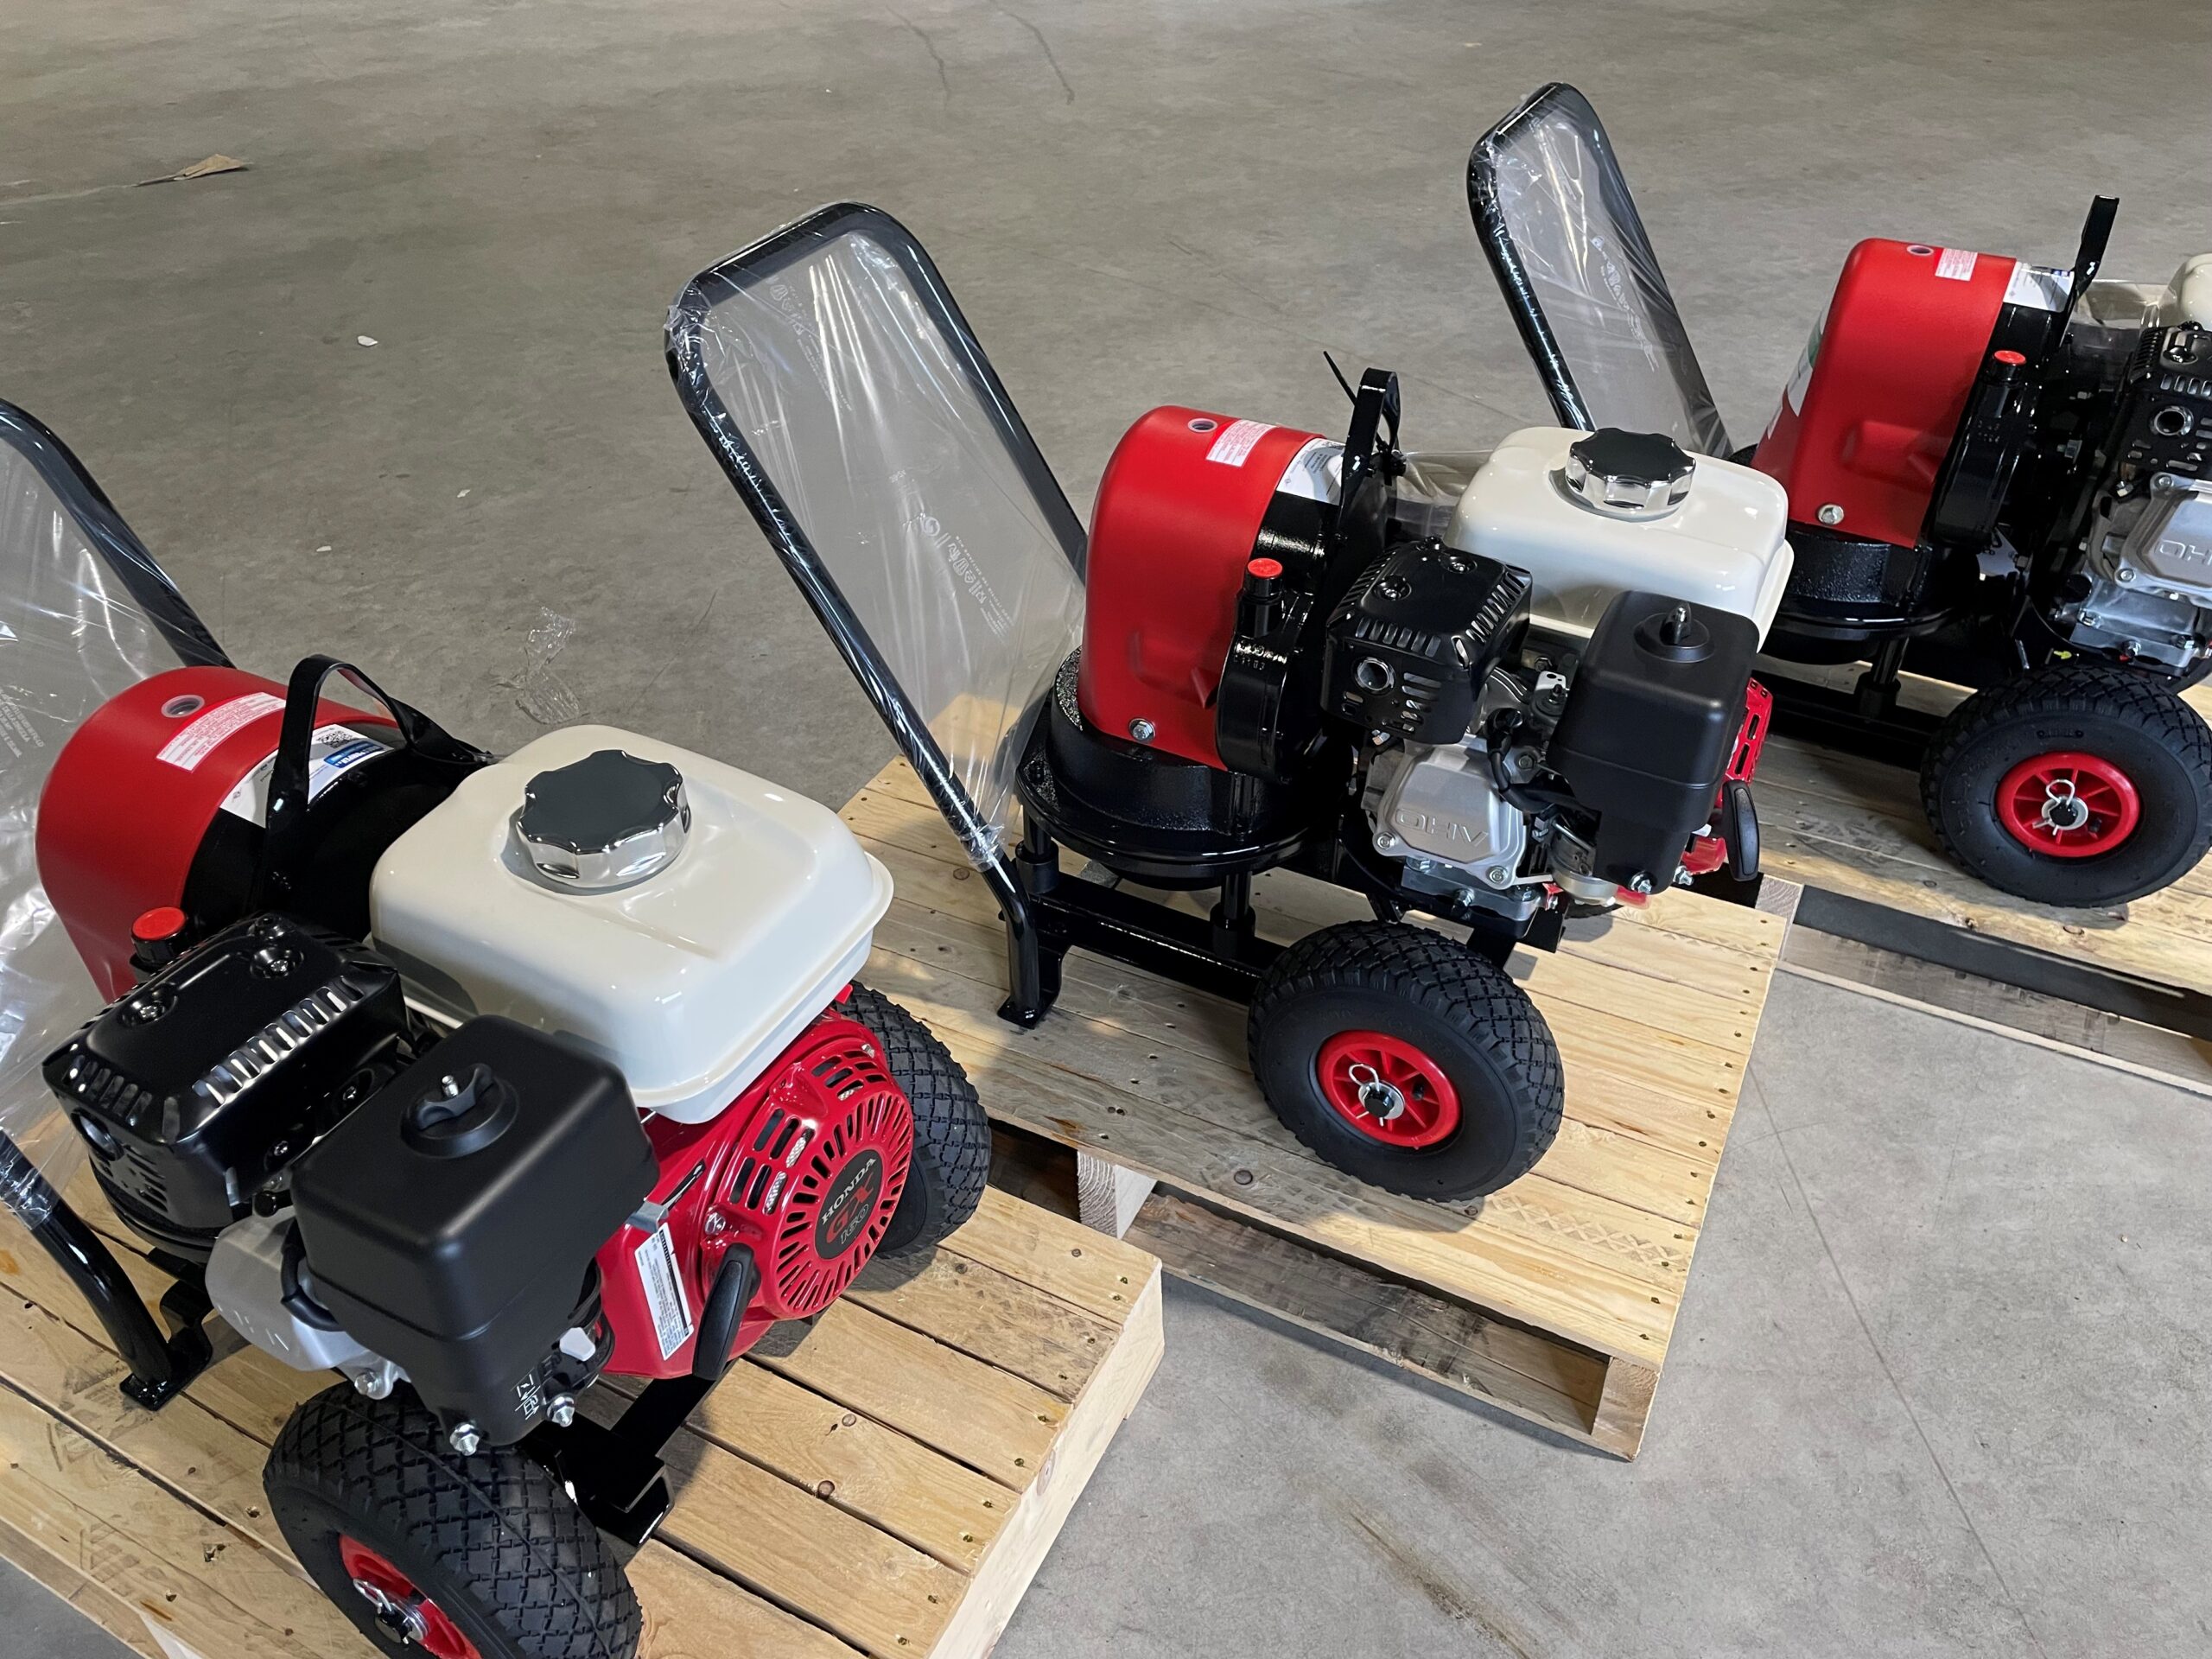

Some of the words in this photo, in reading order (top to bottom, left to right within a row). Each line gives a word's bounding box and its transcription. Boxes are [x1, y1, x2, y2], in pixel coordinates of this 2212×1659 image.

[1396, 810, 1489, 847] OHV
[821, 1158, 877, 1225] HONDA
[826, 1172, 874, 1243] GX
